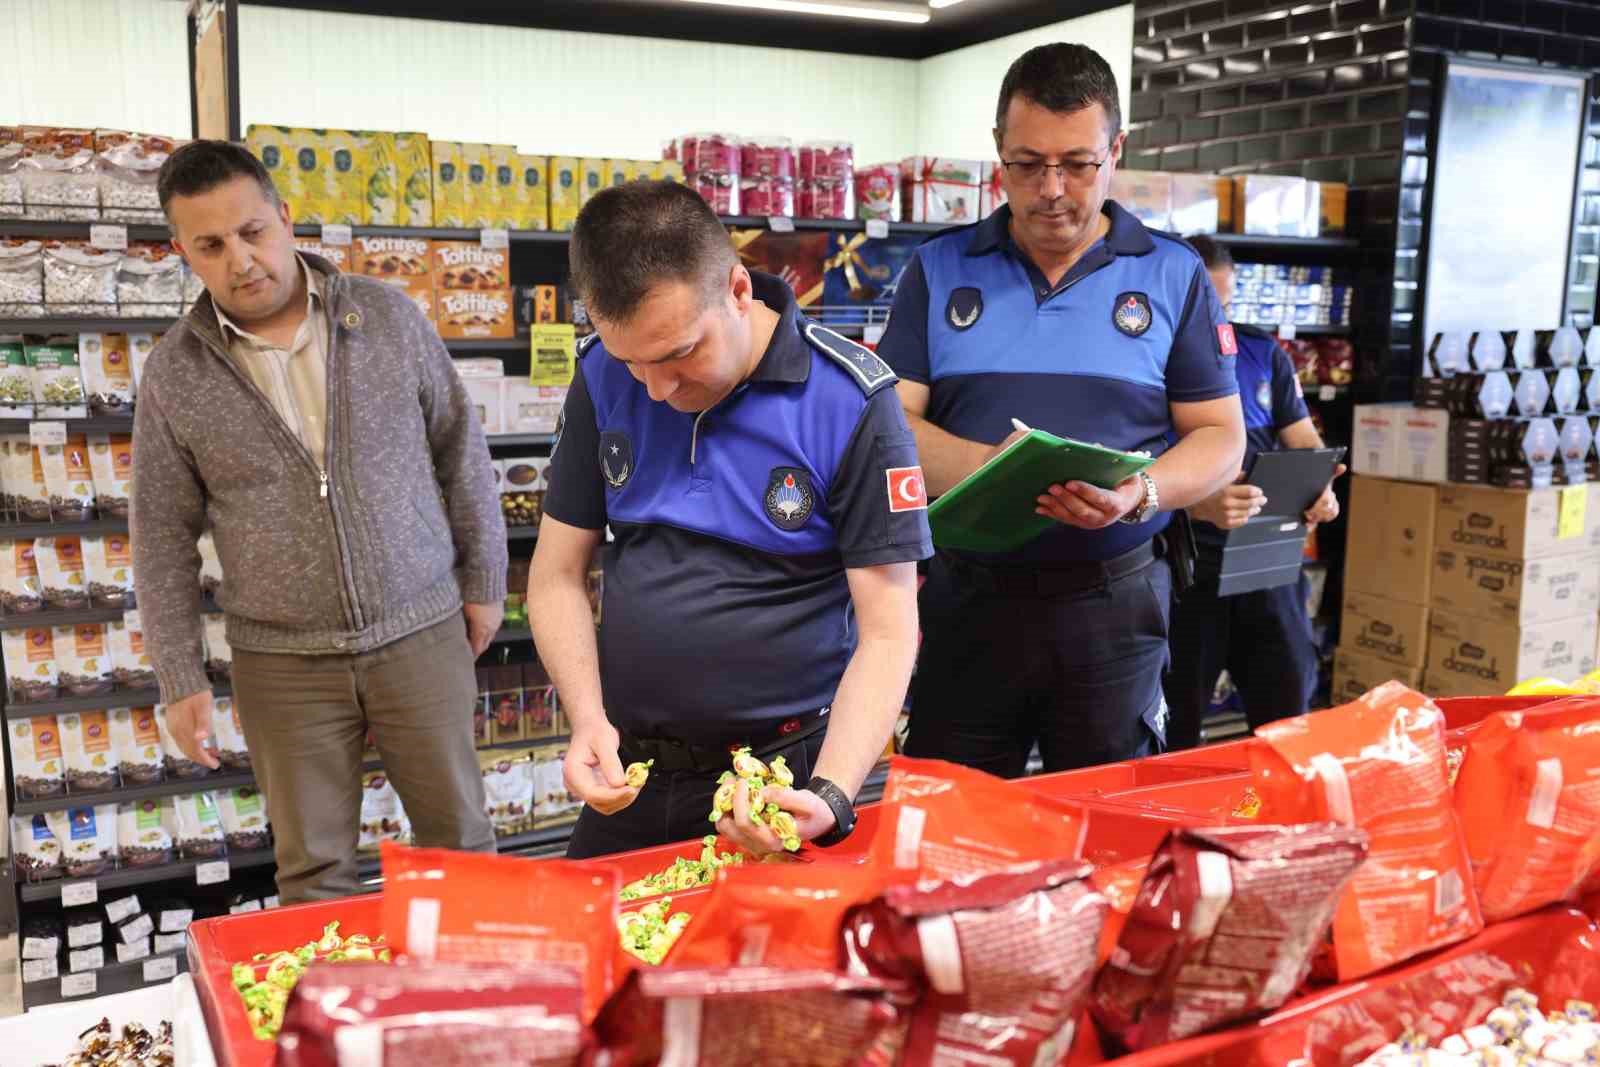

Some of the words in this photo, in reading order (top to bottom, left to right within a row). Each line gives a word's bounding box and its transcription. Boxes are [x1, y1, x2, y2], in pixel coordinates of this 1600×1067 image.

[1452, 520, 1507, 548] damak
[1356, 628, 1406, 656] damak
[1443, 649, 1499, 680] damak
